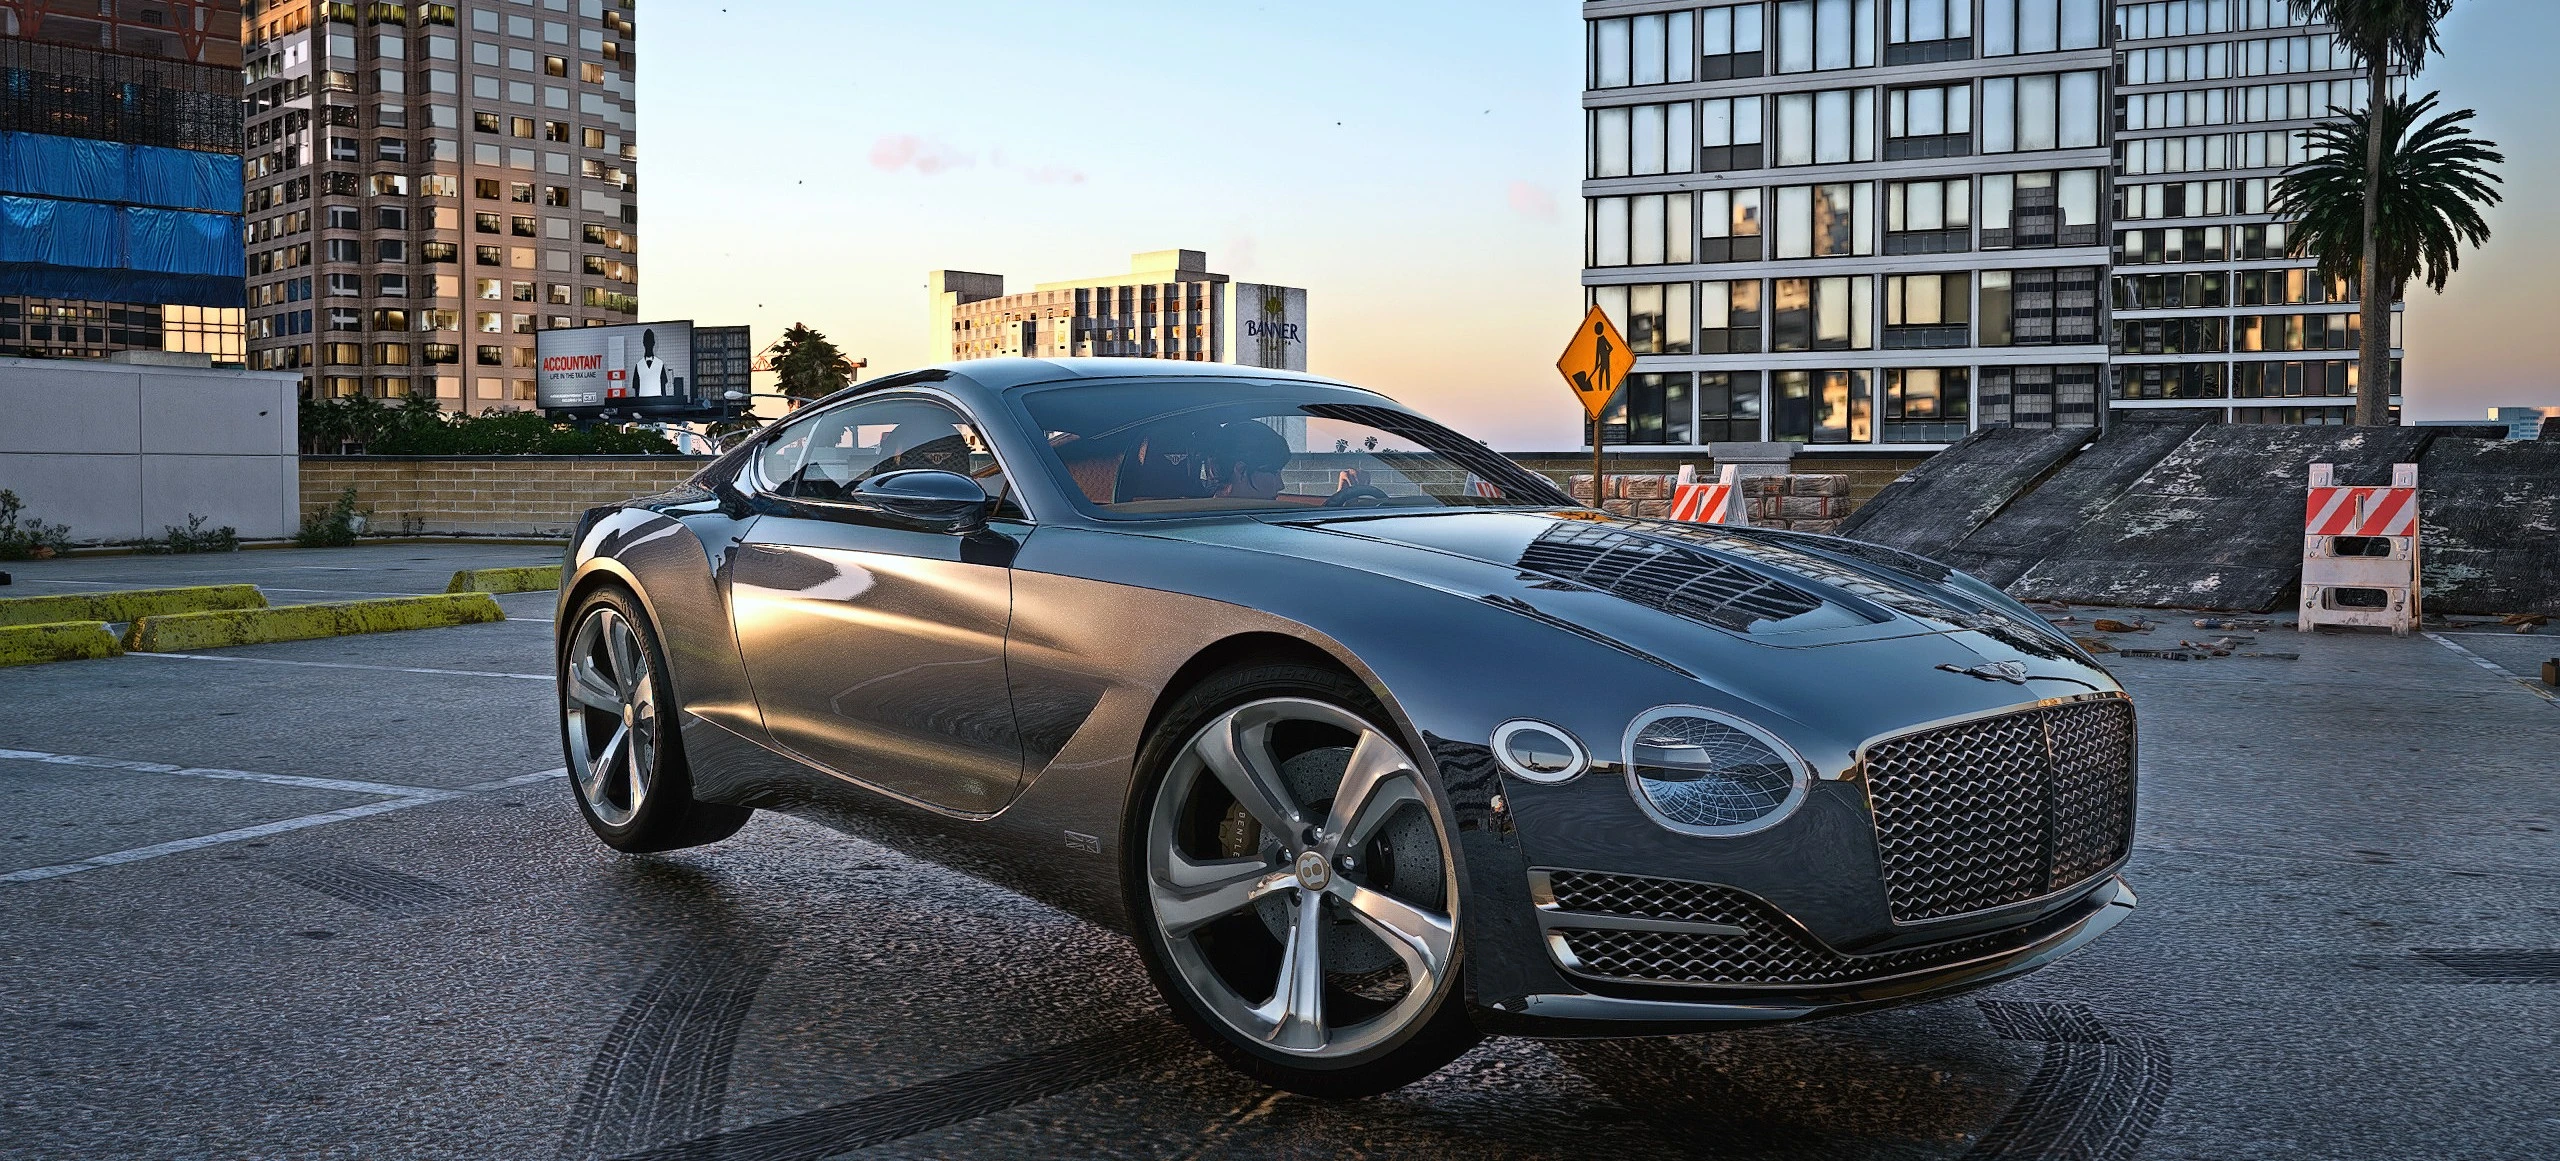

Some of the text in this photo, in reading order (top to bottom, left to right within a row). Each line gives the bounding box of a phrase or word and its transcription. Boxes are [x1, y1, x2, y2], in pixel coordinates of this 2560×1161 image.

[1245, 320, 1301, 343] BANNER
[543, 354, 603, 371] ACCOUNTANT
[584, 371, 597, 379] LANE
